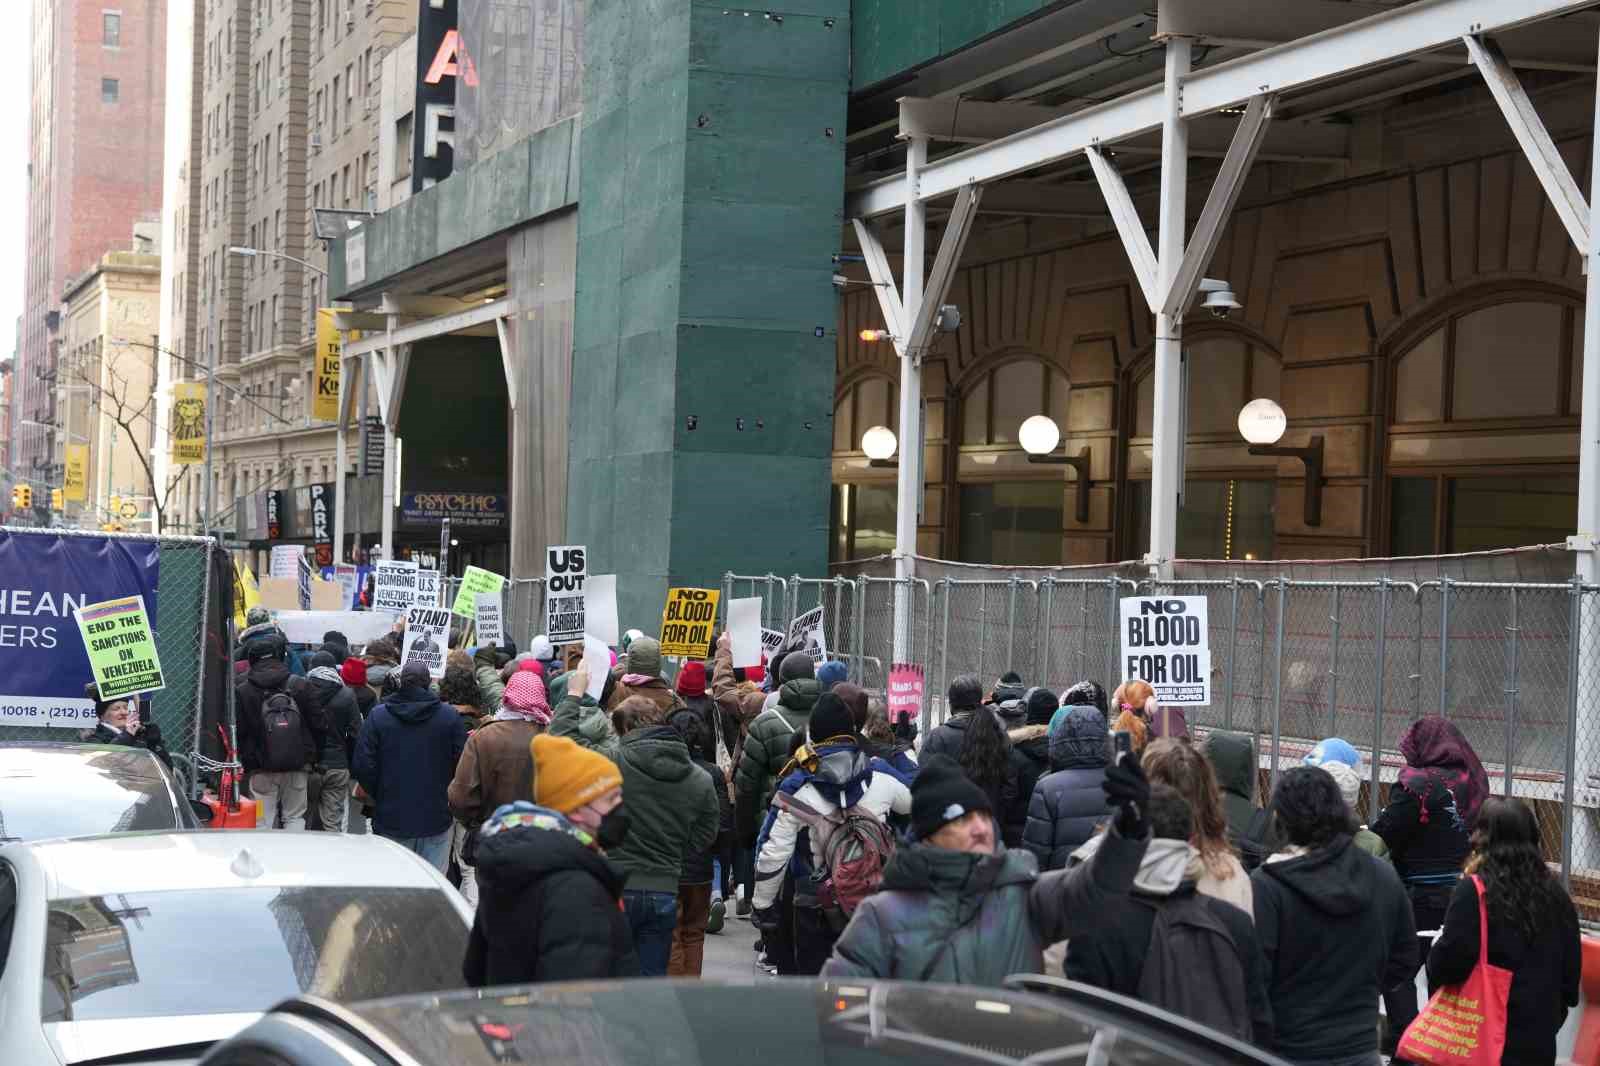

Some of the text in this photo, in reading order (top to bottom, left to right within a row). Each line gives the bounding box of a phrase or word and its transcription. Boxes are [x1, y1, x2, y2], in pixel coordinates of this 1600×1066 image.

[328, 344, 340, 353] TH
[323, 358, 340, 375] LIO
[268, 491, 277, 523] PARK
[415, 494, 497, 511] PSYCHIC
[312, 485, 328, 538] PARK
[549, 549, 585, 574] US
[378, 566, 416, 575] STOP
[378, 573, 416, 588] BOMBING
[418, 578, 436, 592] U.S.
[549, 575, 585, 592] OUT
[377, 589, 415, 602] VENEZUELA
[677, 589, 708, 601] NO
[549, 597, 558, 613] OF
[575, 596, 585, 612] THE
[667, 600, 714, 621] BLOOD
[1140, 599, 1187, 615] NO
[87, 615, 142, 634] END THE
[408, 608, 449, 627] STAND
[549, 611, 585, 633] CARIBBEAN
[791, 610, 822, 635] STAND
[409, 625, 445, 635] WITH THE
[662, 624, 708, 644] FOR OIL
[761, 630, 783, 647] AND
[1128, 615, 1200, 647] BLOOD
[91, 630, 147, 651] SANCTIONS
[118, 648, 134, 661] ON
[407, 650, 442, 662] BOLIVARIAN
[102, 658, 156, 680] VENEZUELA
[1127, 654, 1204, 683] FOR OIL
[2, 705, 38, 717] 10018
[49, 706, 79, 719] (212)
